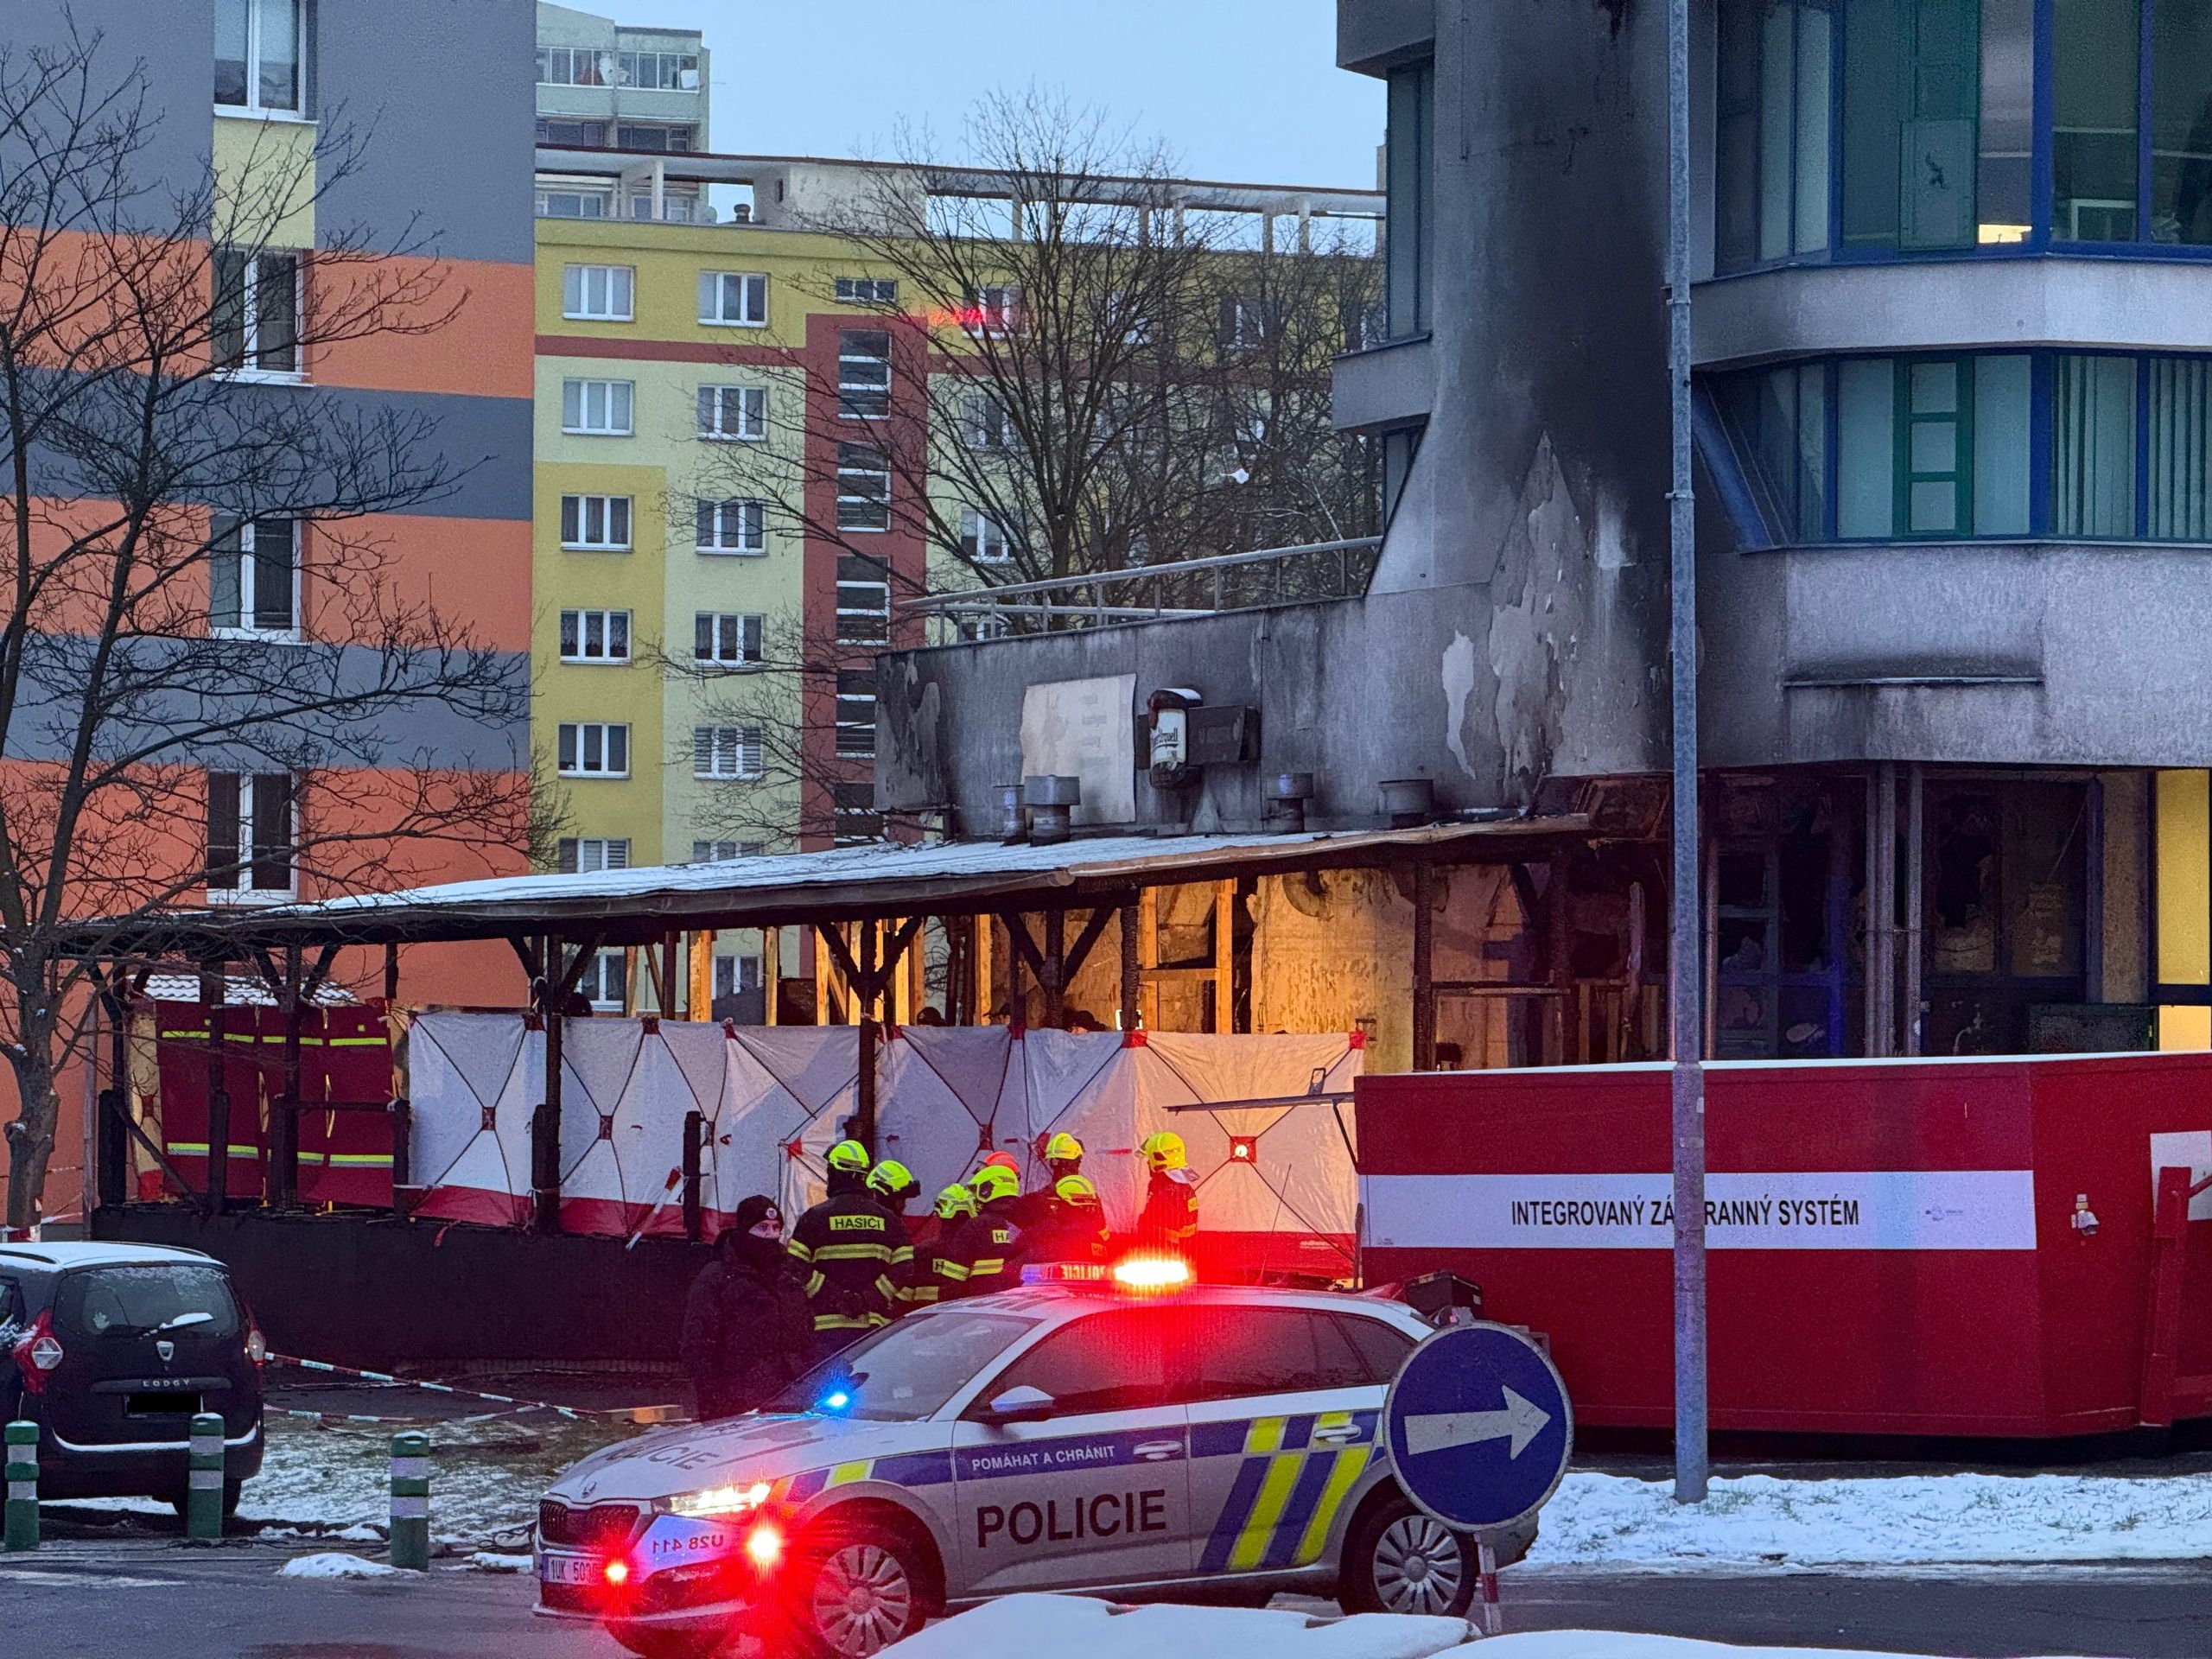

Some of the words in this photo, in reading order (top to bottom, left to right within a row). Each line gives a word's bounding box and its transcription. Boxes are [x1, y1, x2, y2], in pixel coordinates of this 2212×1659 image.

[1512, 1195, 1645, 1226] INTEGROVANÝ
[1651, 1194, 1772, 1226] ZÁRANNÝ
[1778, 1194, 1859, 1225] SYSTÉM
[143, 1379, 190, 1388] LODGY
[972, 1452, 1039, 1471] POMÁHAT
[1043, 1452, 1053, 1465] A
[1056, 1445, 1116, 1464] CHRÁNIT
[977, 1489, 1166, 1548] POLICIE
